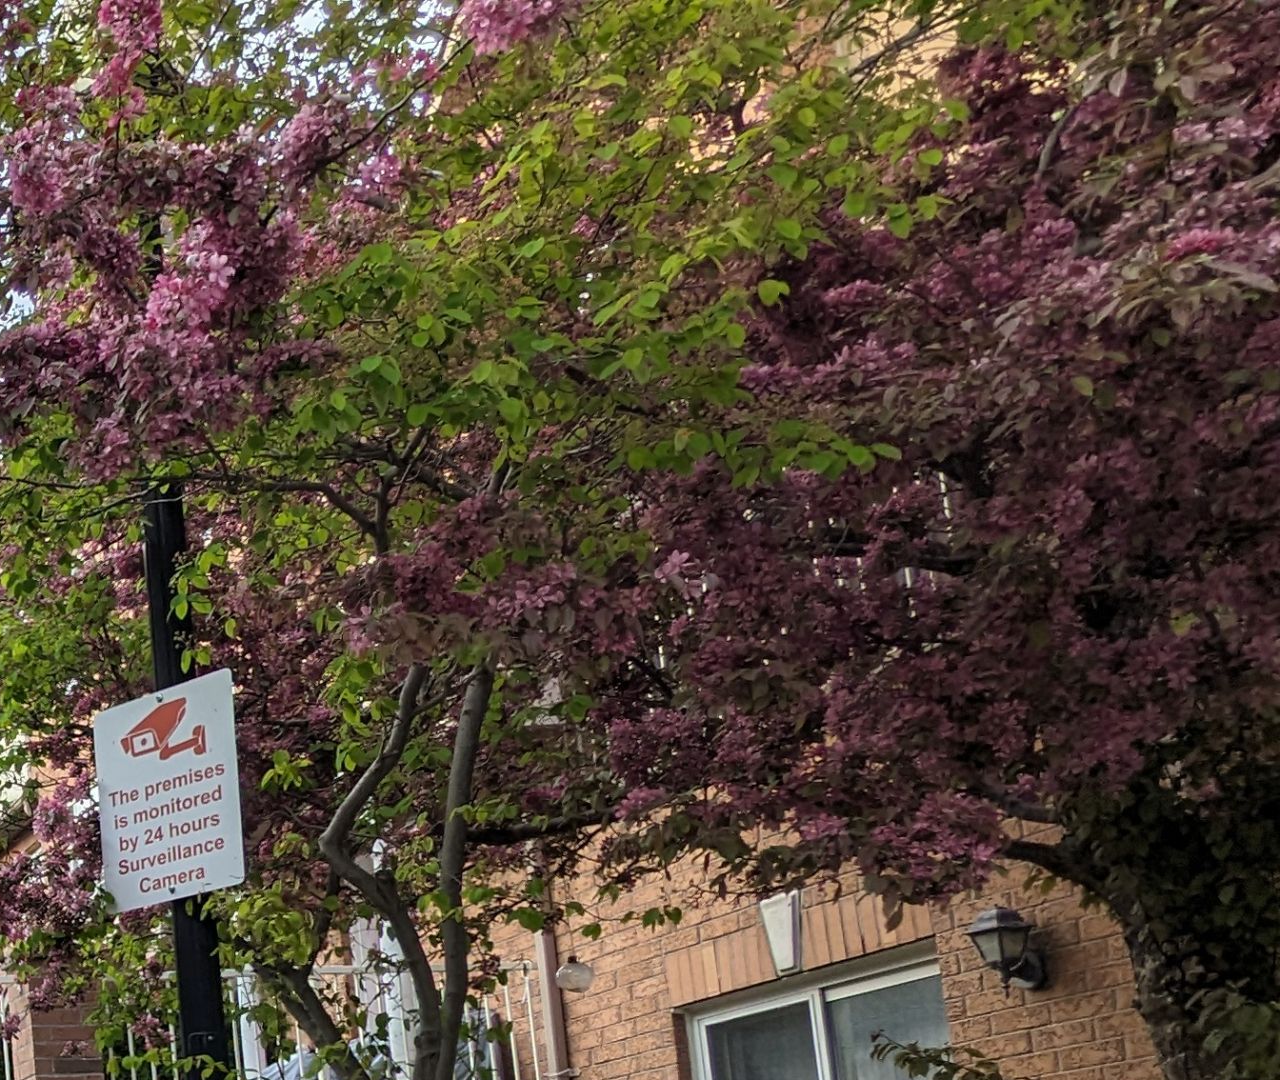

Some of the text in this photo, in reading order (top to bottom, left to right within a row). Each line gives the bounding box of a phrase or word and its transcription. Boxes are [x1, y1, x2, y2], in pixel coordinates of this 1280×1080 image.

[109, 763, 225, 807] The premises
[114, 785, 222, 830] is monitored
[120, 813, 220, 853] by 24 hours
[118, 836, 225, 876] Surveillance
[139, 865, 205, 893] Camera
